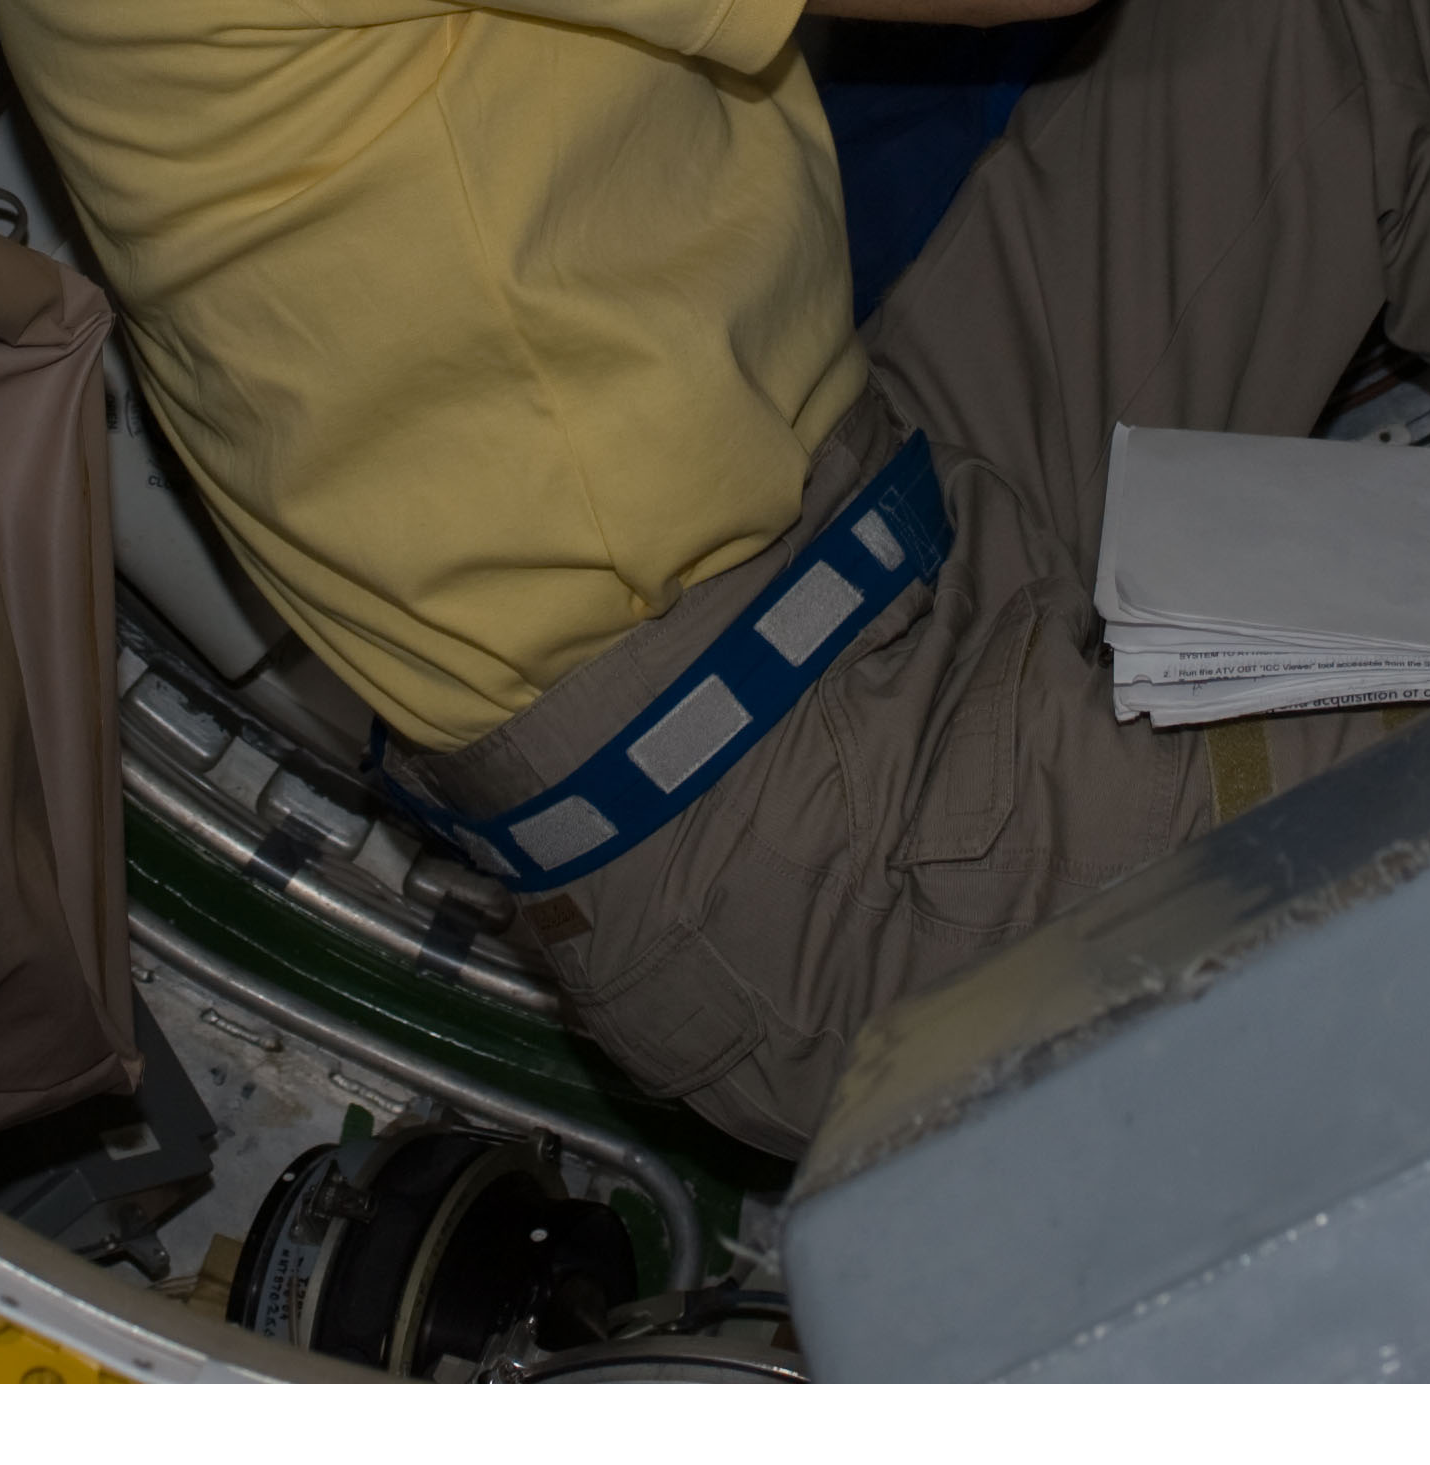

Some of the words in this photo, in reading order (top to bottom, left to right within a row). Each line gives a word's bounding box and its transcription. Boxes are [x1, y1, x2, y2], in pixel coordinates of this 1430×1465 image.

[1215, 667, 1235, 675] ATV
[1317, 662, 1334, 670] tool
[1312, 691, 1398, 709] acquisition
